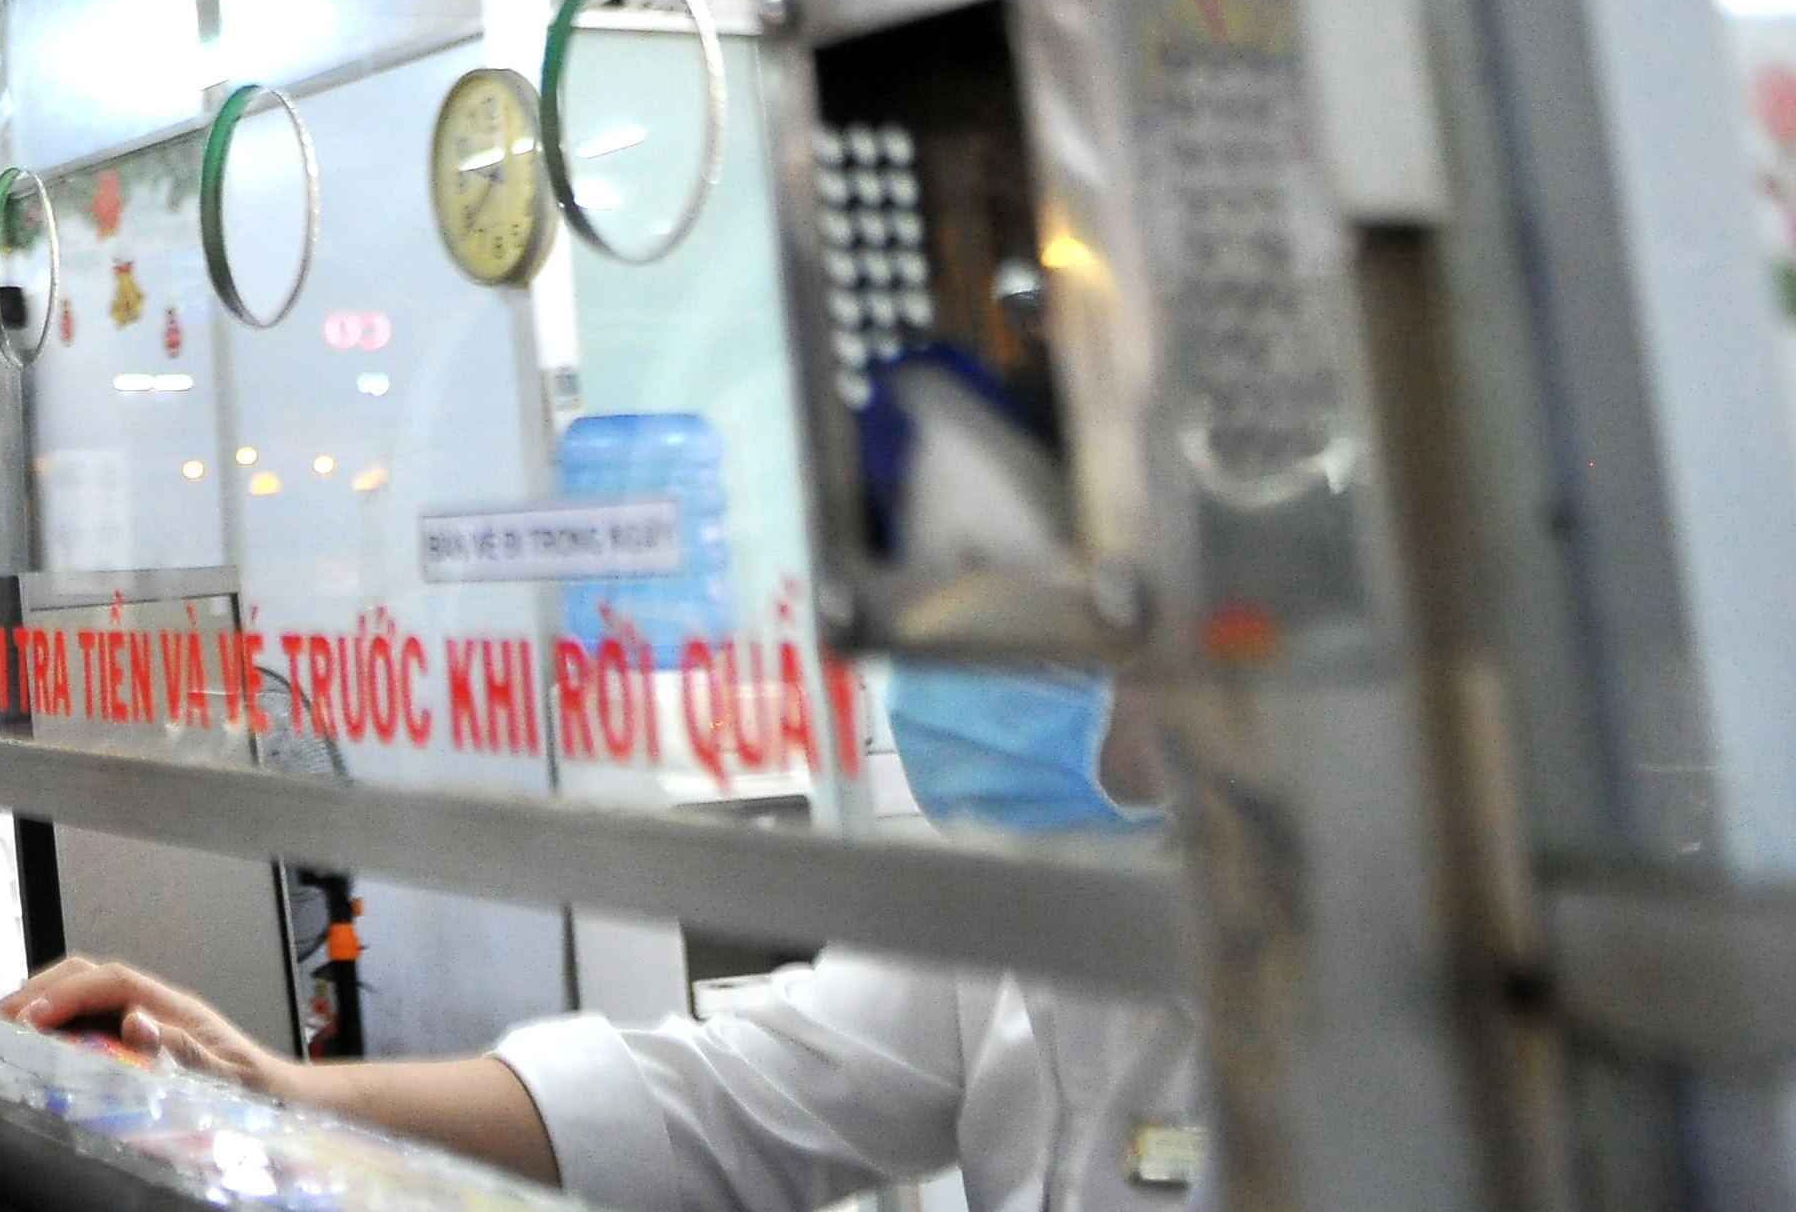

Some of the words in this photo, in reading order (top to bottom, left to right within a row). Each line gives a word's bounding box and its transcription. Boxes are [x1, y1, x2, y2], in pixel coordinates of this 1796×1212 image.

[12, 625, 72, 718] TRA
[77, 589, 153, 724] TIỀN
[160, 602, 210, 730] VÀ
[218, 605, 272, 737] VÉ
[280, 604, 432, 748] TRƯỚC
[446, 638, 541, 758] KHI
[552, 598, 662, 764] RỜI
